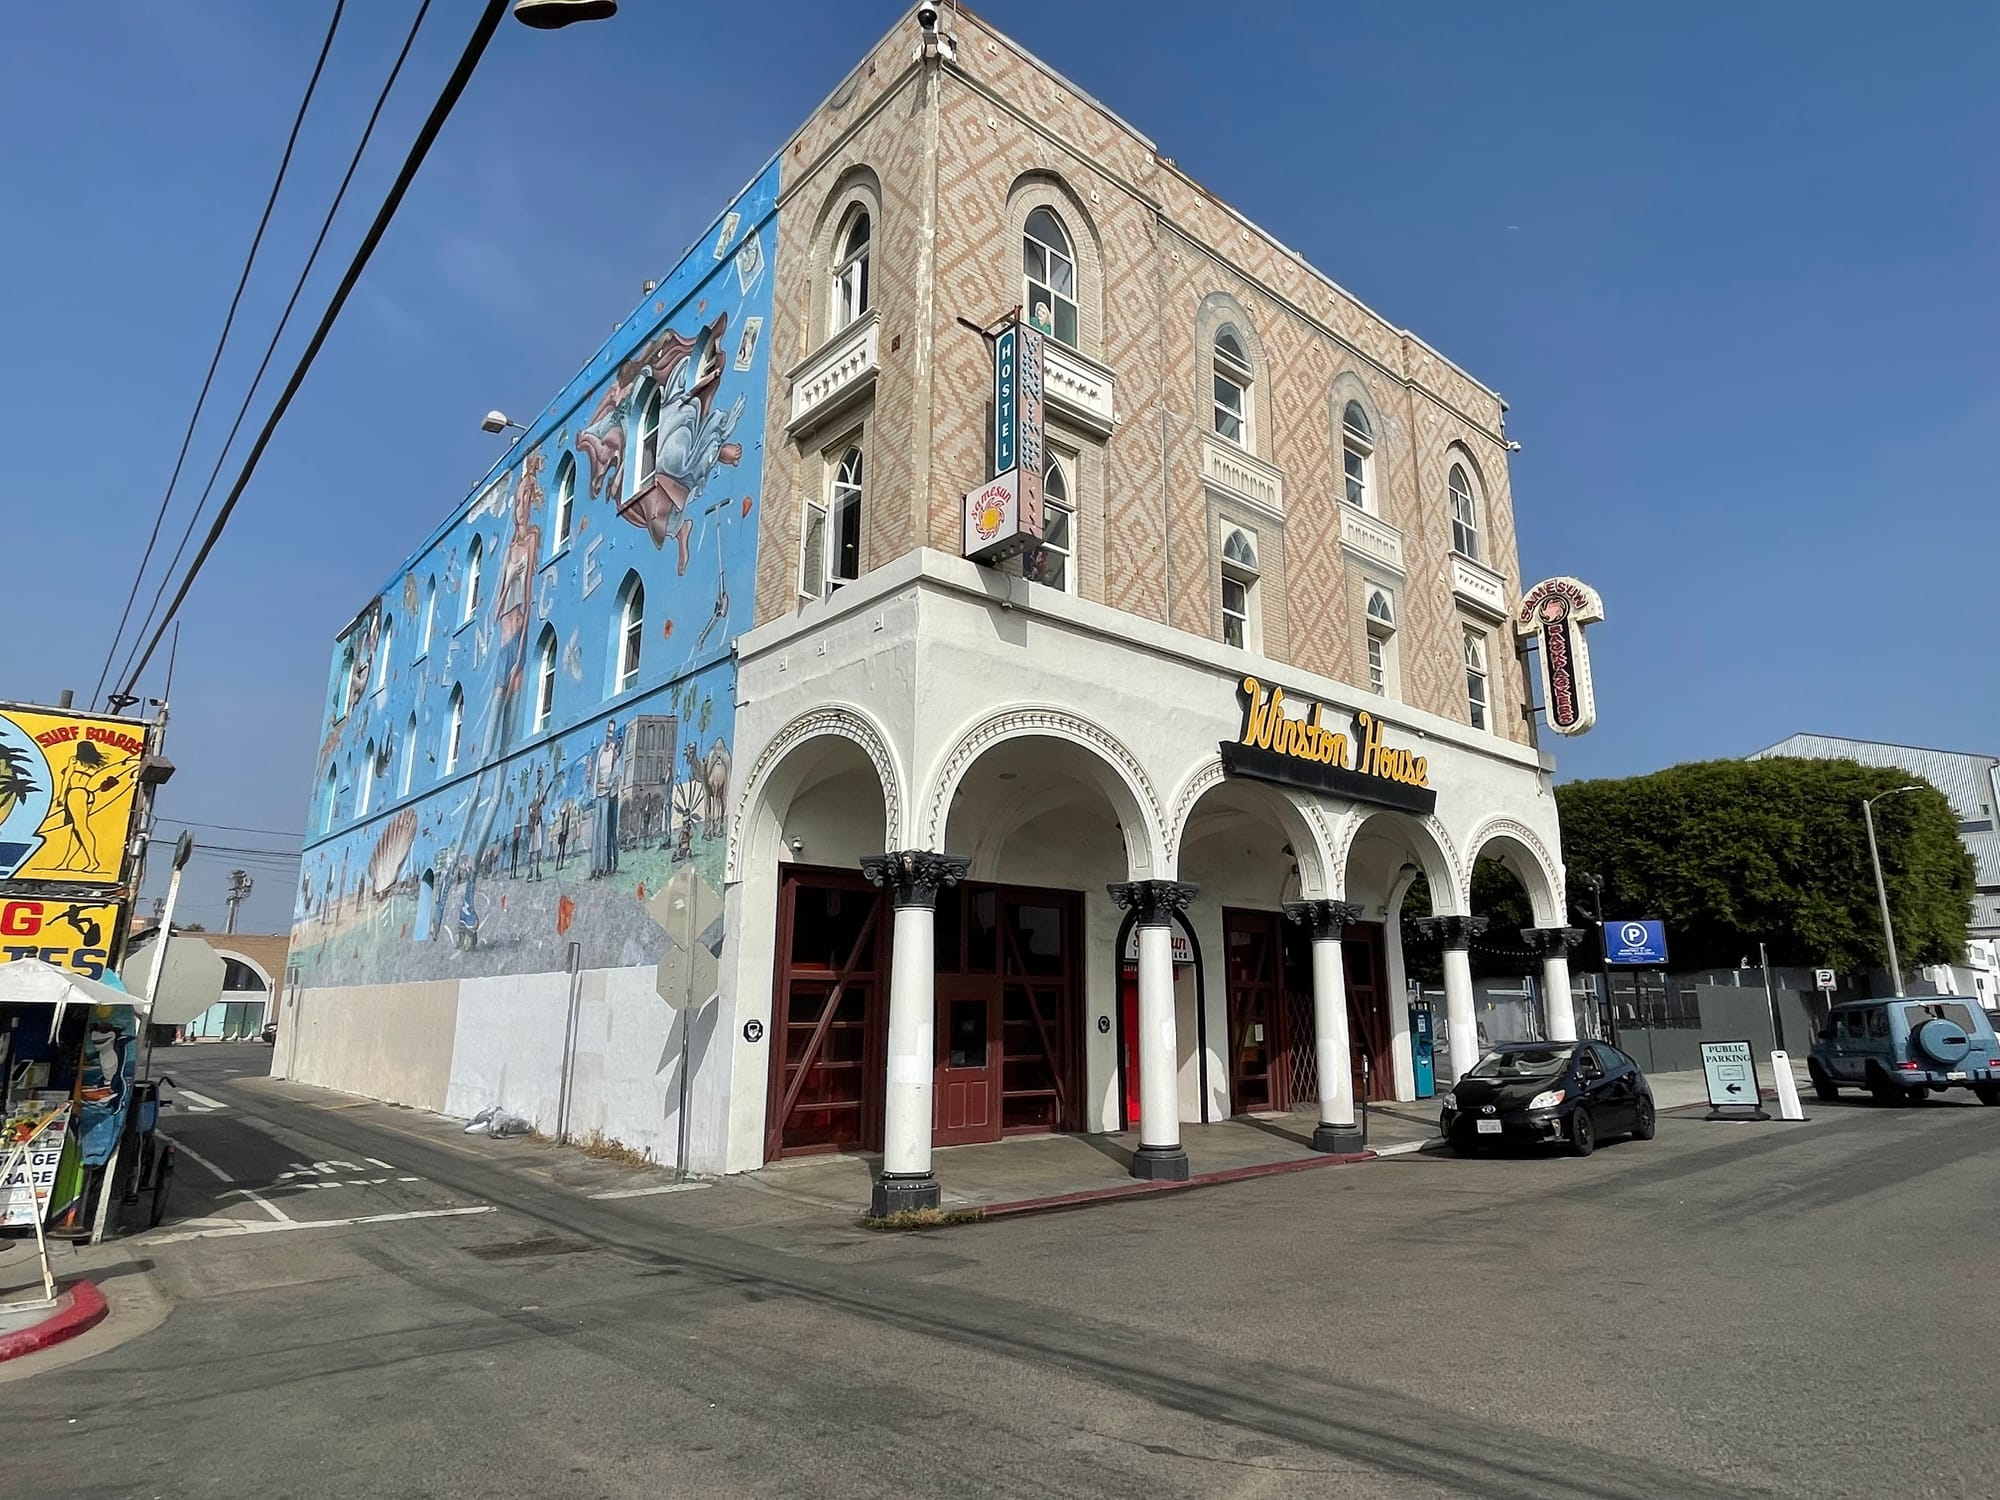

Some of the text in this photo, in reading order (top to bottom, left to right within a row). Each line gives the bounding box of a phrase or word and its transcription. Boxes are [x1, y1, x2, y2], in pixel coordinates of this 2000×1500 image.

[1001, 343, 1012, 457] HOSTEL
[970, 485, 1012, 520] samesun
[1520, 580, 1588, 622] SAMESUN
[35, 725, 145, 756] SURF BOARDS
[1242, 676, 1429, 787] Winston House
[1706, 1054, 1752, 1063] PARKING
[1708, 1044, 1745, 1053] PUBLIC
